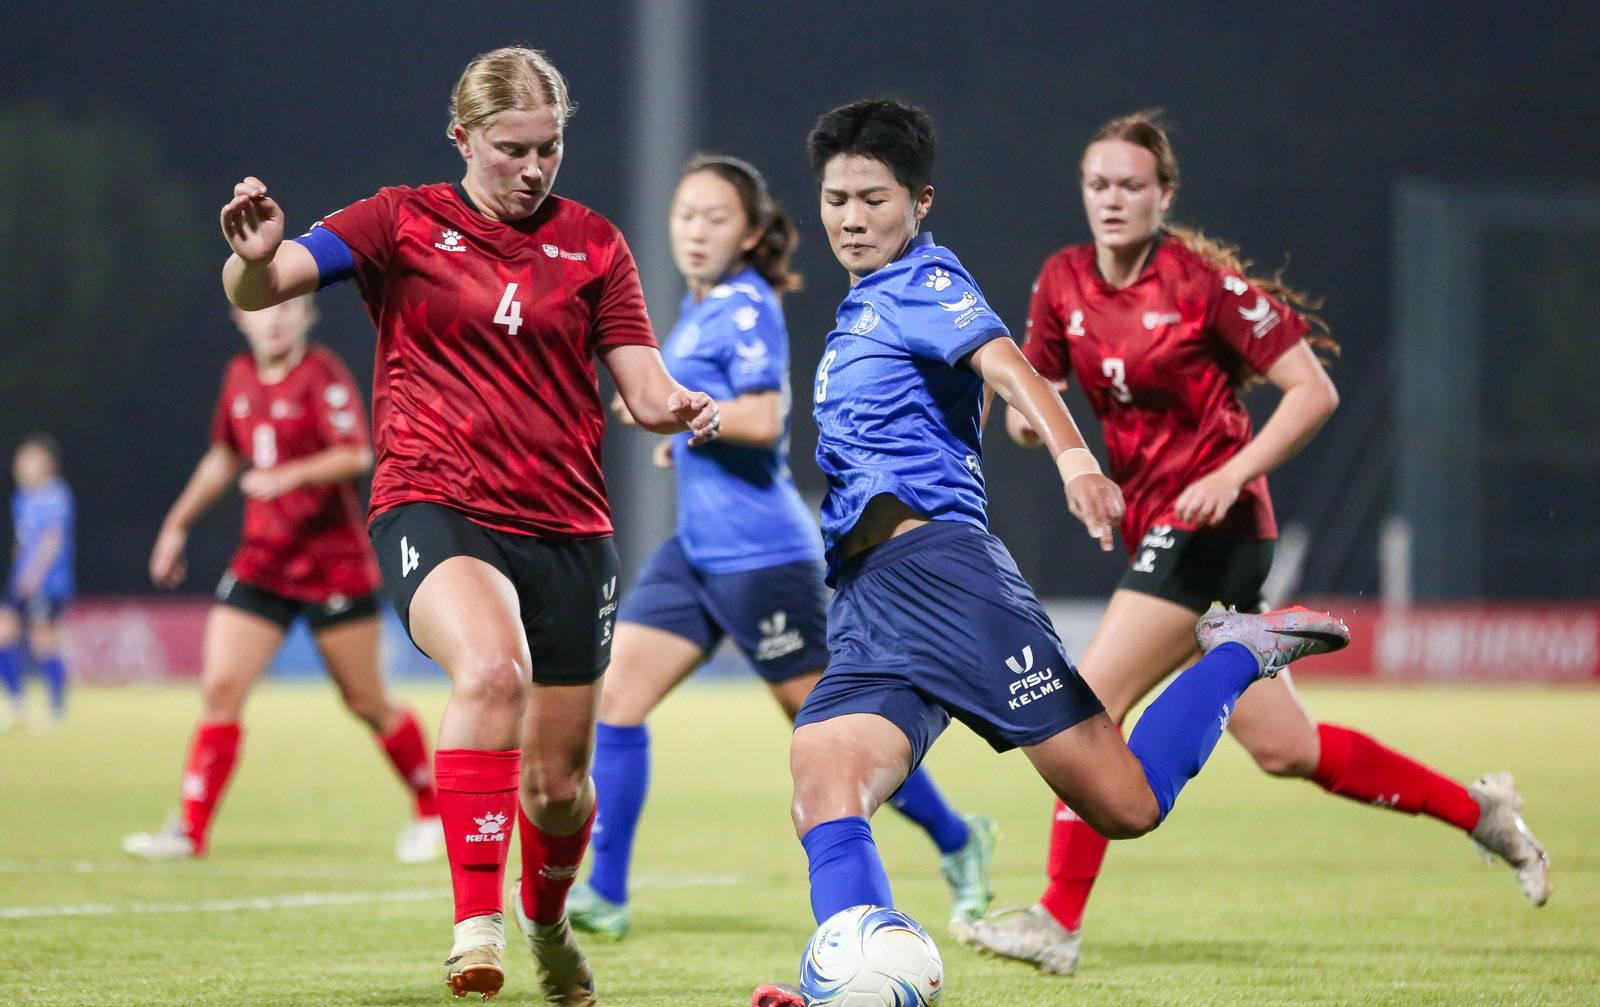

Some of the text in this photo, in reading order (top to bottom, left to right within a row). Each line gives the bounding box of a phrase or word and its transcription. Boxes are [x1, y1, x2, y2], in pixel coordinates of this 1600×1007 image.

[434, 242, 467, 252] KELME
[493, 282, 523, 336] 4
[816, 350, 837, 404] 9
[1102, 357, 1133, 403] 3
[400, 535, 420, 578] 4
[1008, 678, 1064, 710] KELME
[1009, 667, 1053, 695] FISU
[465, 833, 505, 843] KELME
